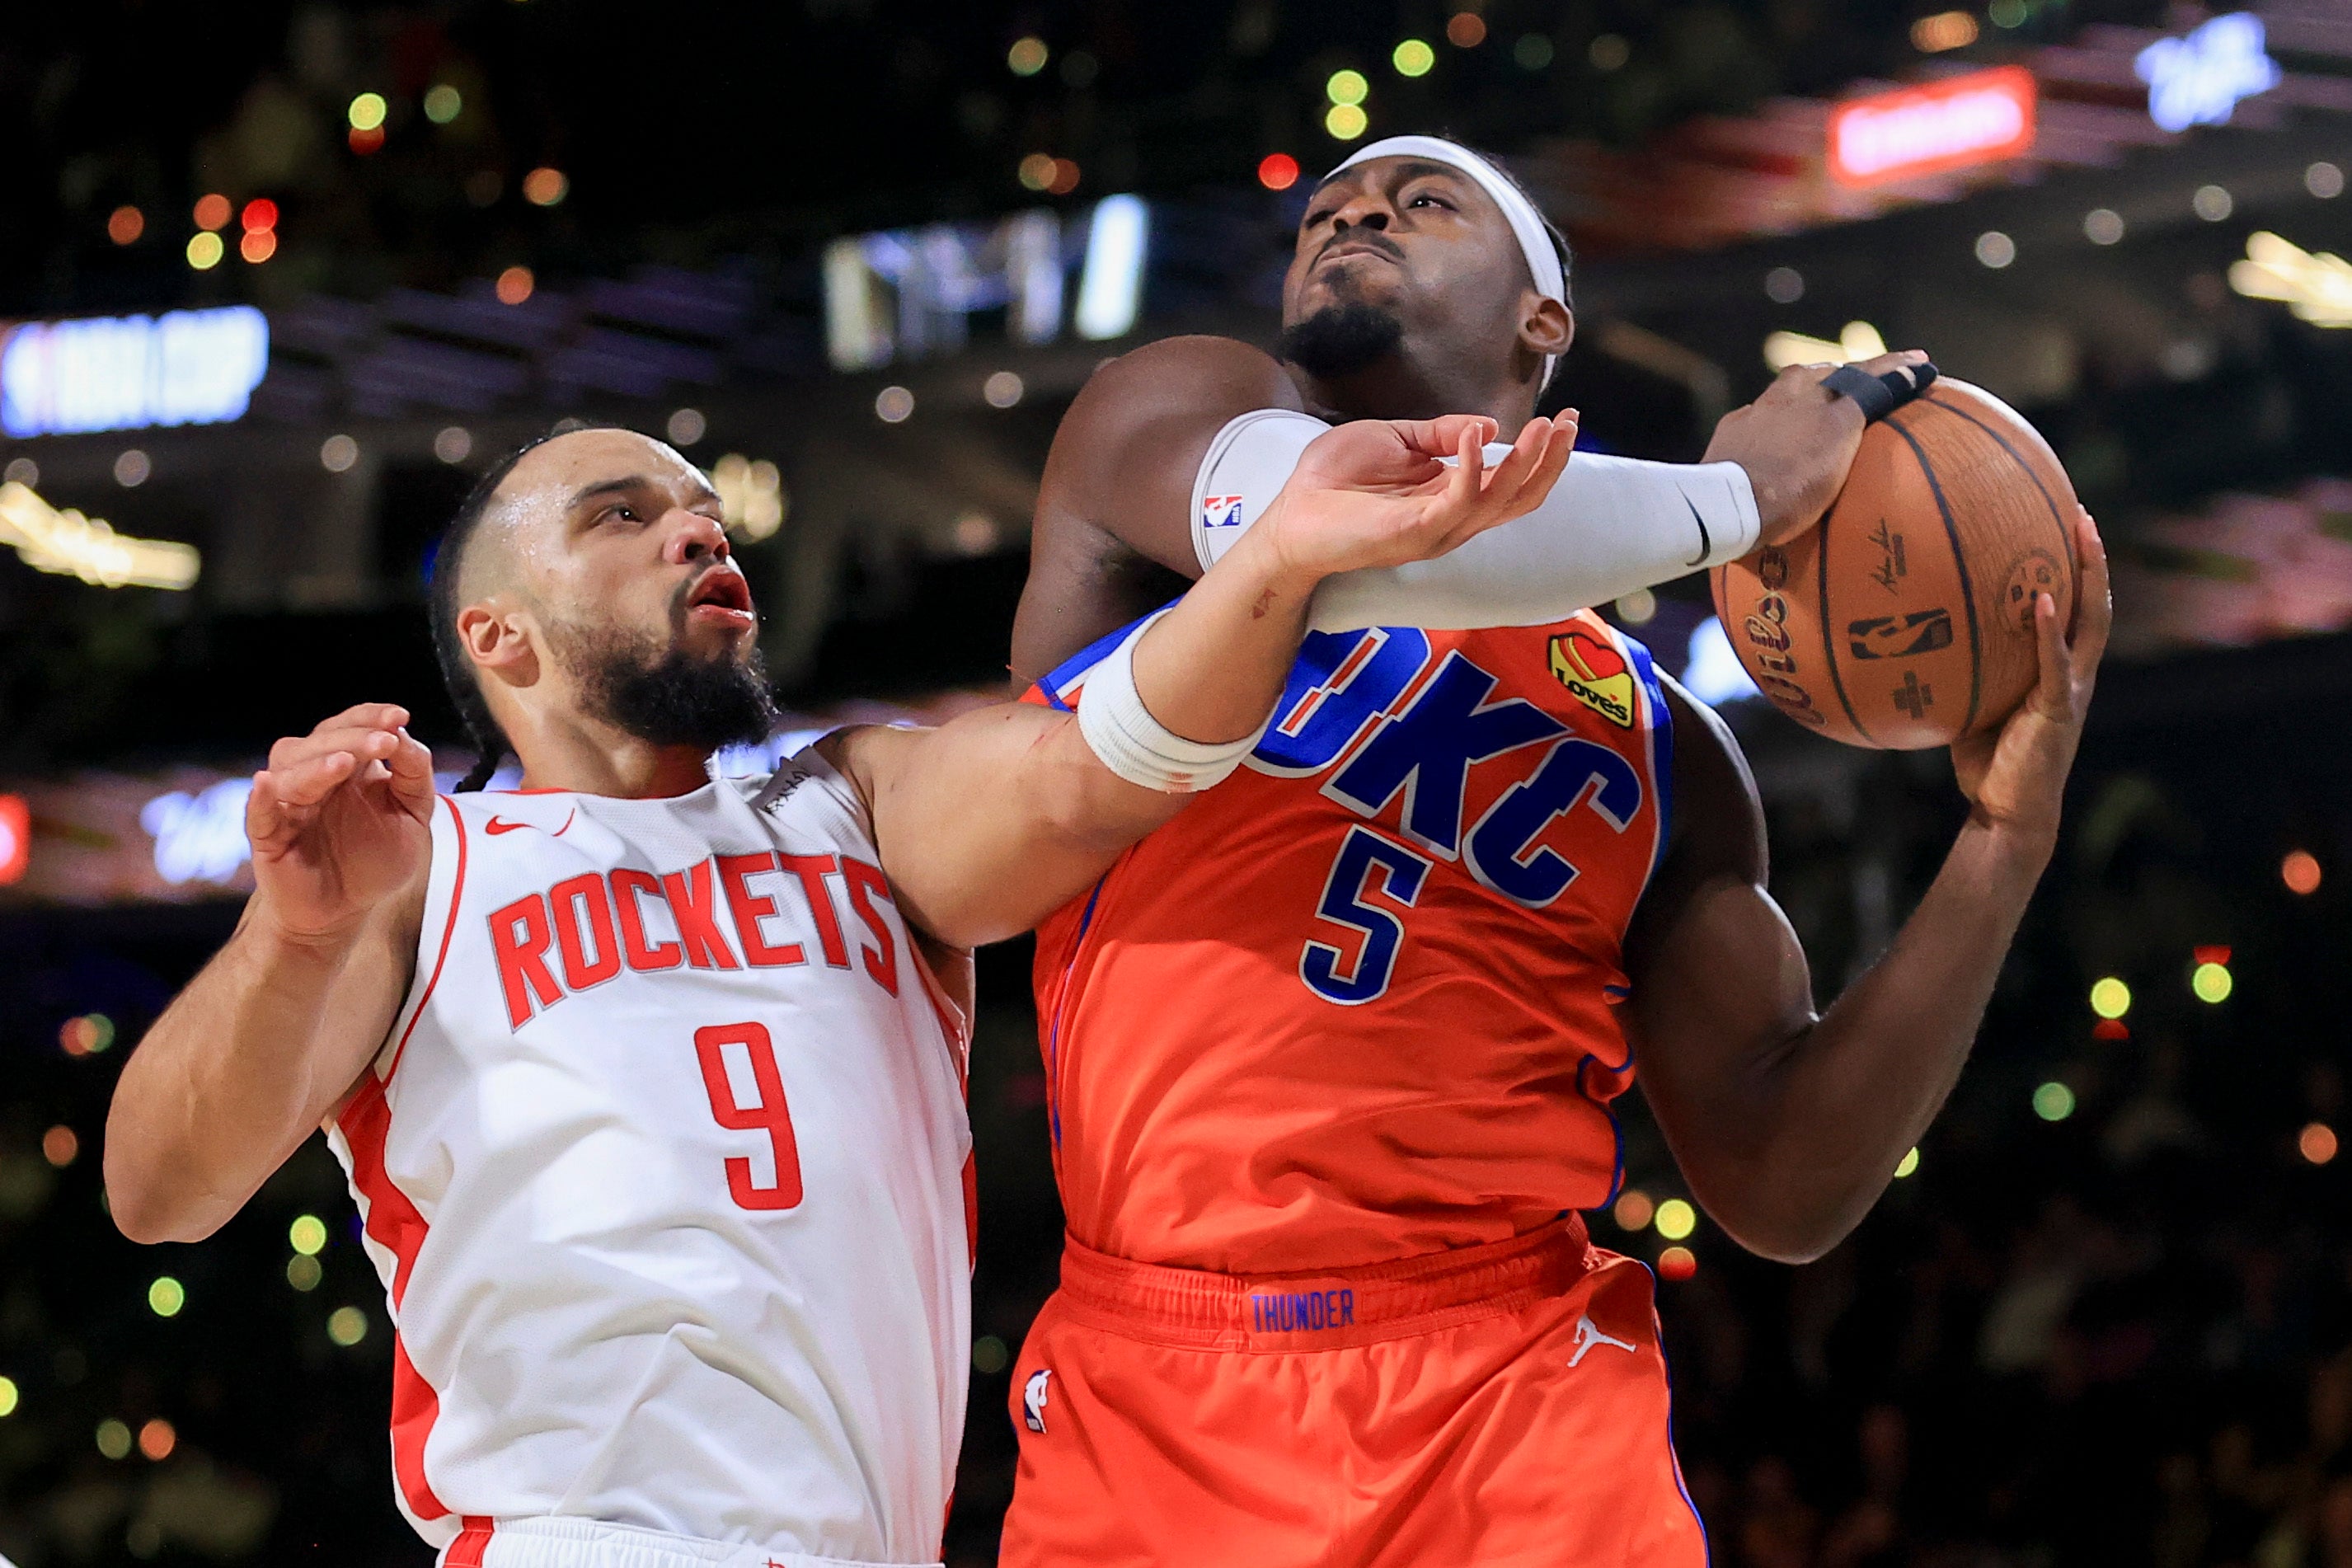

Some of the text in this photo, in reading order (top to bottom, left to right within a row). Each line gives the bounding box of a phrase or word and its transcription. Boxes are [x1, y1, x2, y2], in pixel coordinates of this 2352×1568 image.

[1744, 543, 1828, 727] Wilso
[486, 849, 899, 1035] ROCKETS
[1298, 824, 1434, 1007] 5
[693, 1021, 804, 1210] 9
[1251, 1289, 1354, 1332] THUNDER
